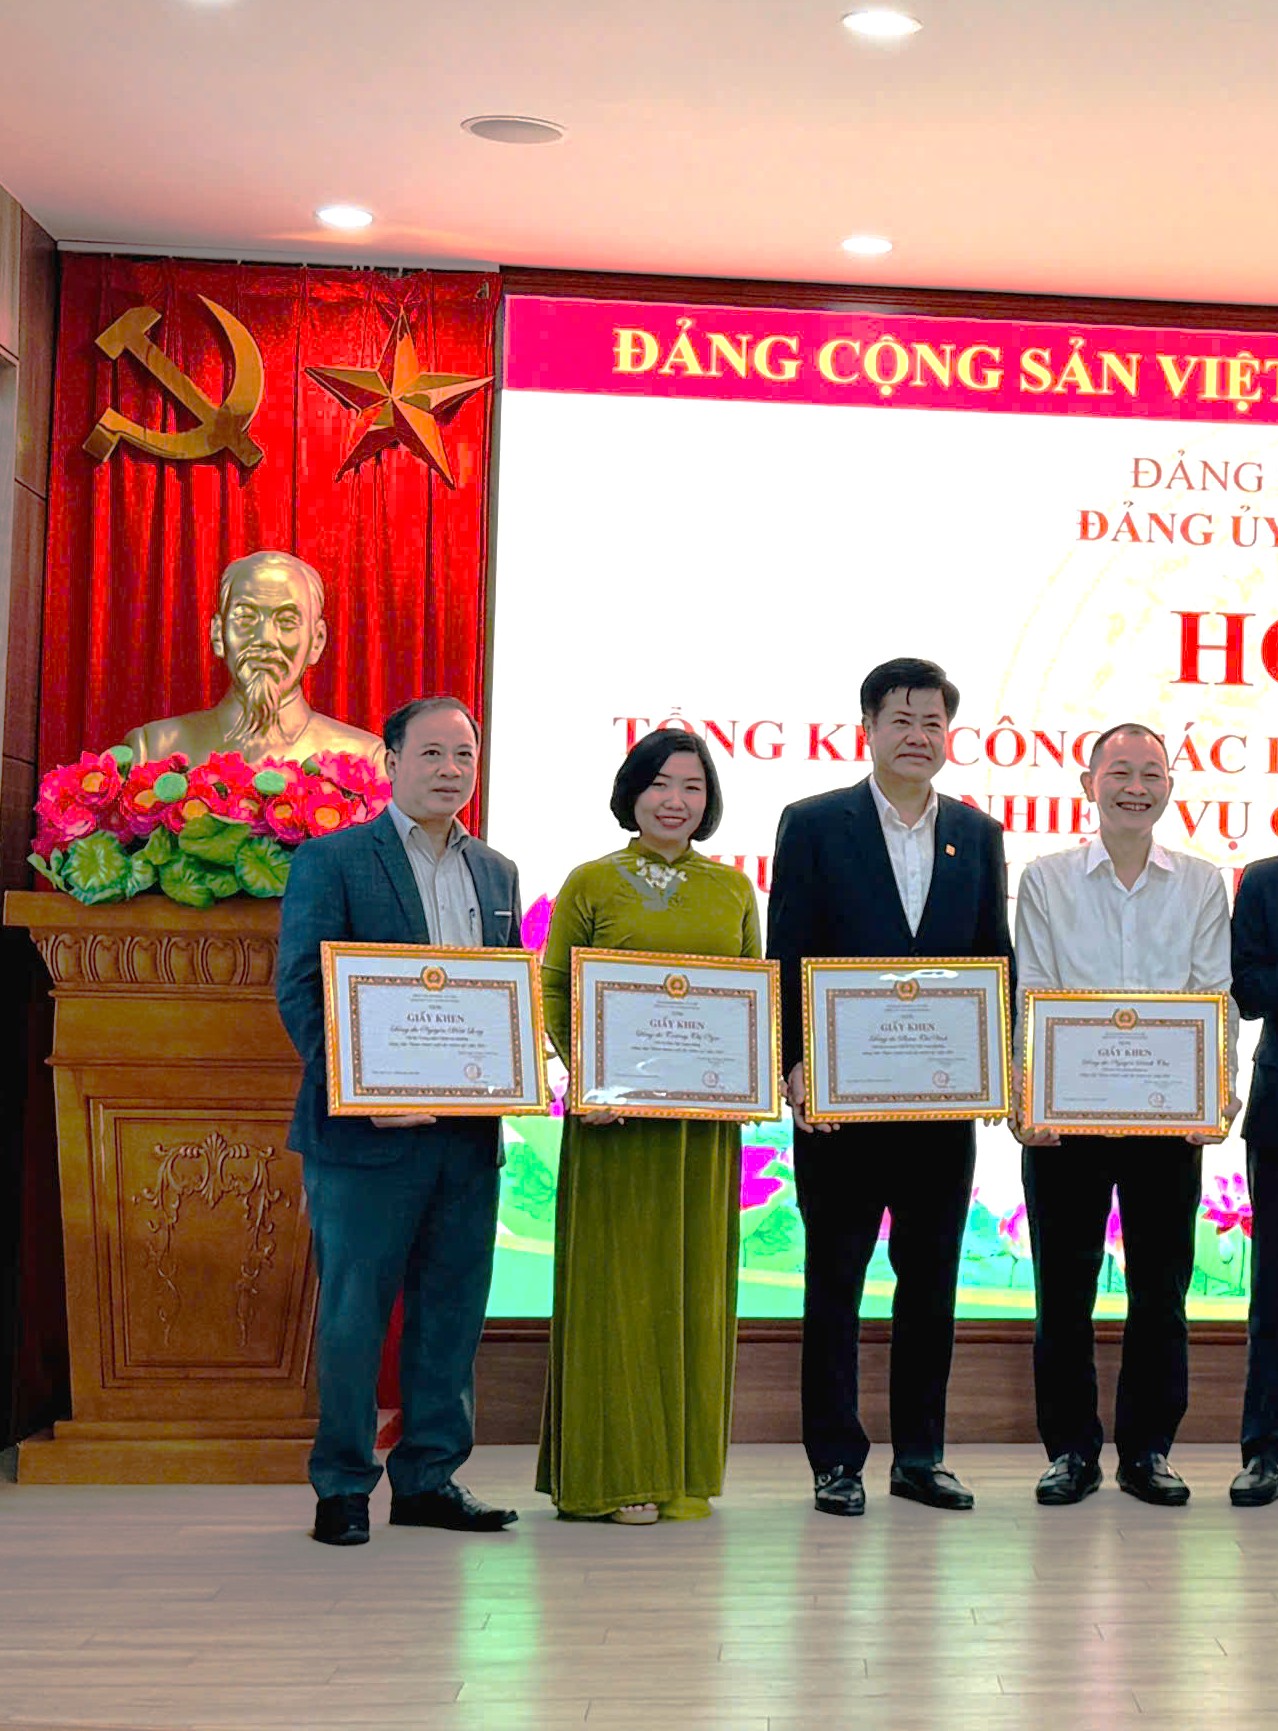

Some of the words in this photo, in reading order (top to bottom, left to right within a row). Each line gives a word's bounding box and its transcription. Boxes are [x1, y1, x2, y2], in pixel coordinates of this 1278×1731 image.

[612, 317, 801, 380] ĐẢNG
[817, 333, 1003, 395] CỘNG
[1019, 336, 1140, 396] SẢN
[1131, 450, 1264, 492] ĐẢNG
[1077, 502, 1214, 546] ĐẢNG
[1161, 722, 1248, 773] ÁC
[1175, 800, 1252, 850] VỤ
